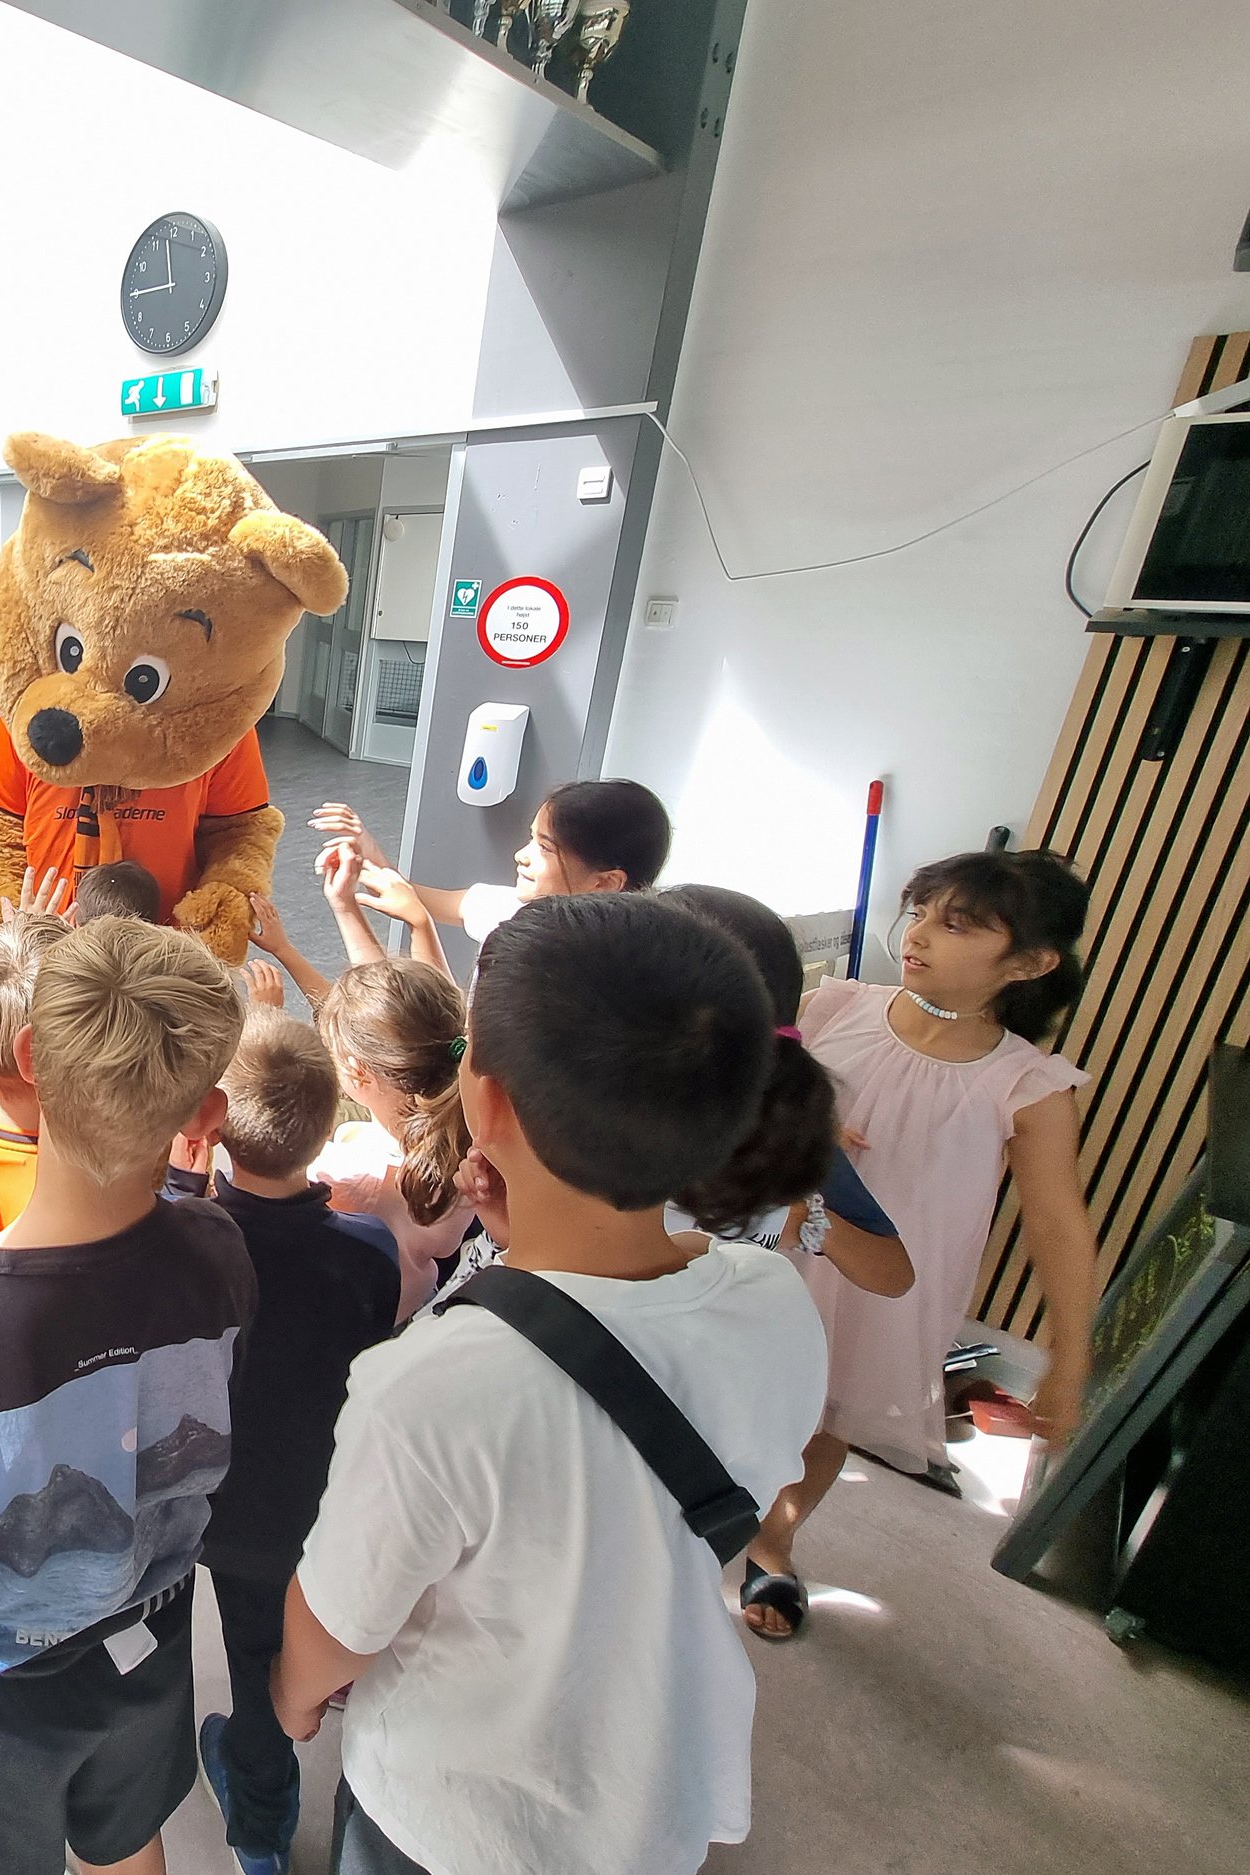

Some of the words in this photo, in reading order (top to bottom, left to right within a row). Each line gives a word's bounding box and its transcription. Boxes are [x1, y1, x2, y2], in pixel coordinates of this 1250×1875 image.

[170, 227, 178, 239] 12
[191, 231, 195, 241] 1
[152, 241, 159, 251] 11
[201, 246, 206, 257] 2
[139, 262, 147, 272] 10
[205, 272, 210, 282] 3
[200, 299, 204, 309] 4
[138, 312, 142, 322] 8
[184, 321, 189, 332] 5
[150, 328, 154, 338] 7
[166, 333, 171, 342] 6
[511, 622, 528, 630] 150
[494, 633, 547, 643] PERSONER
